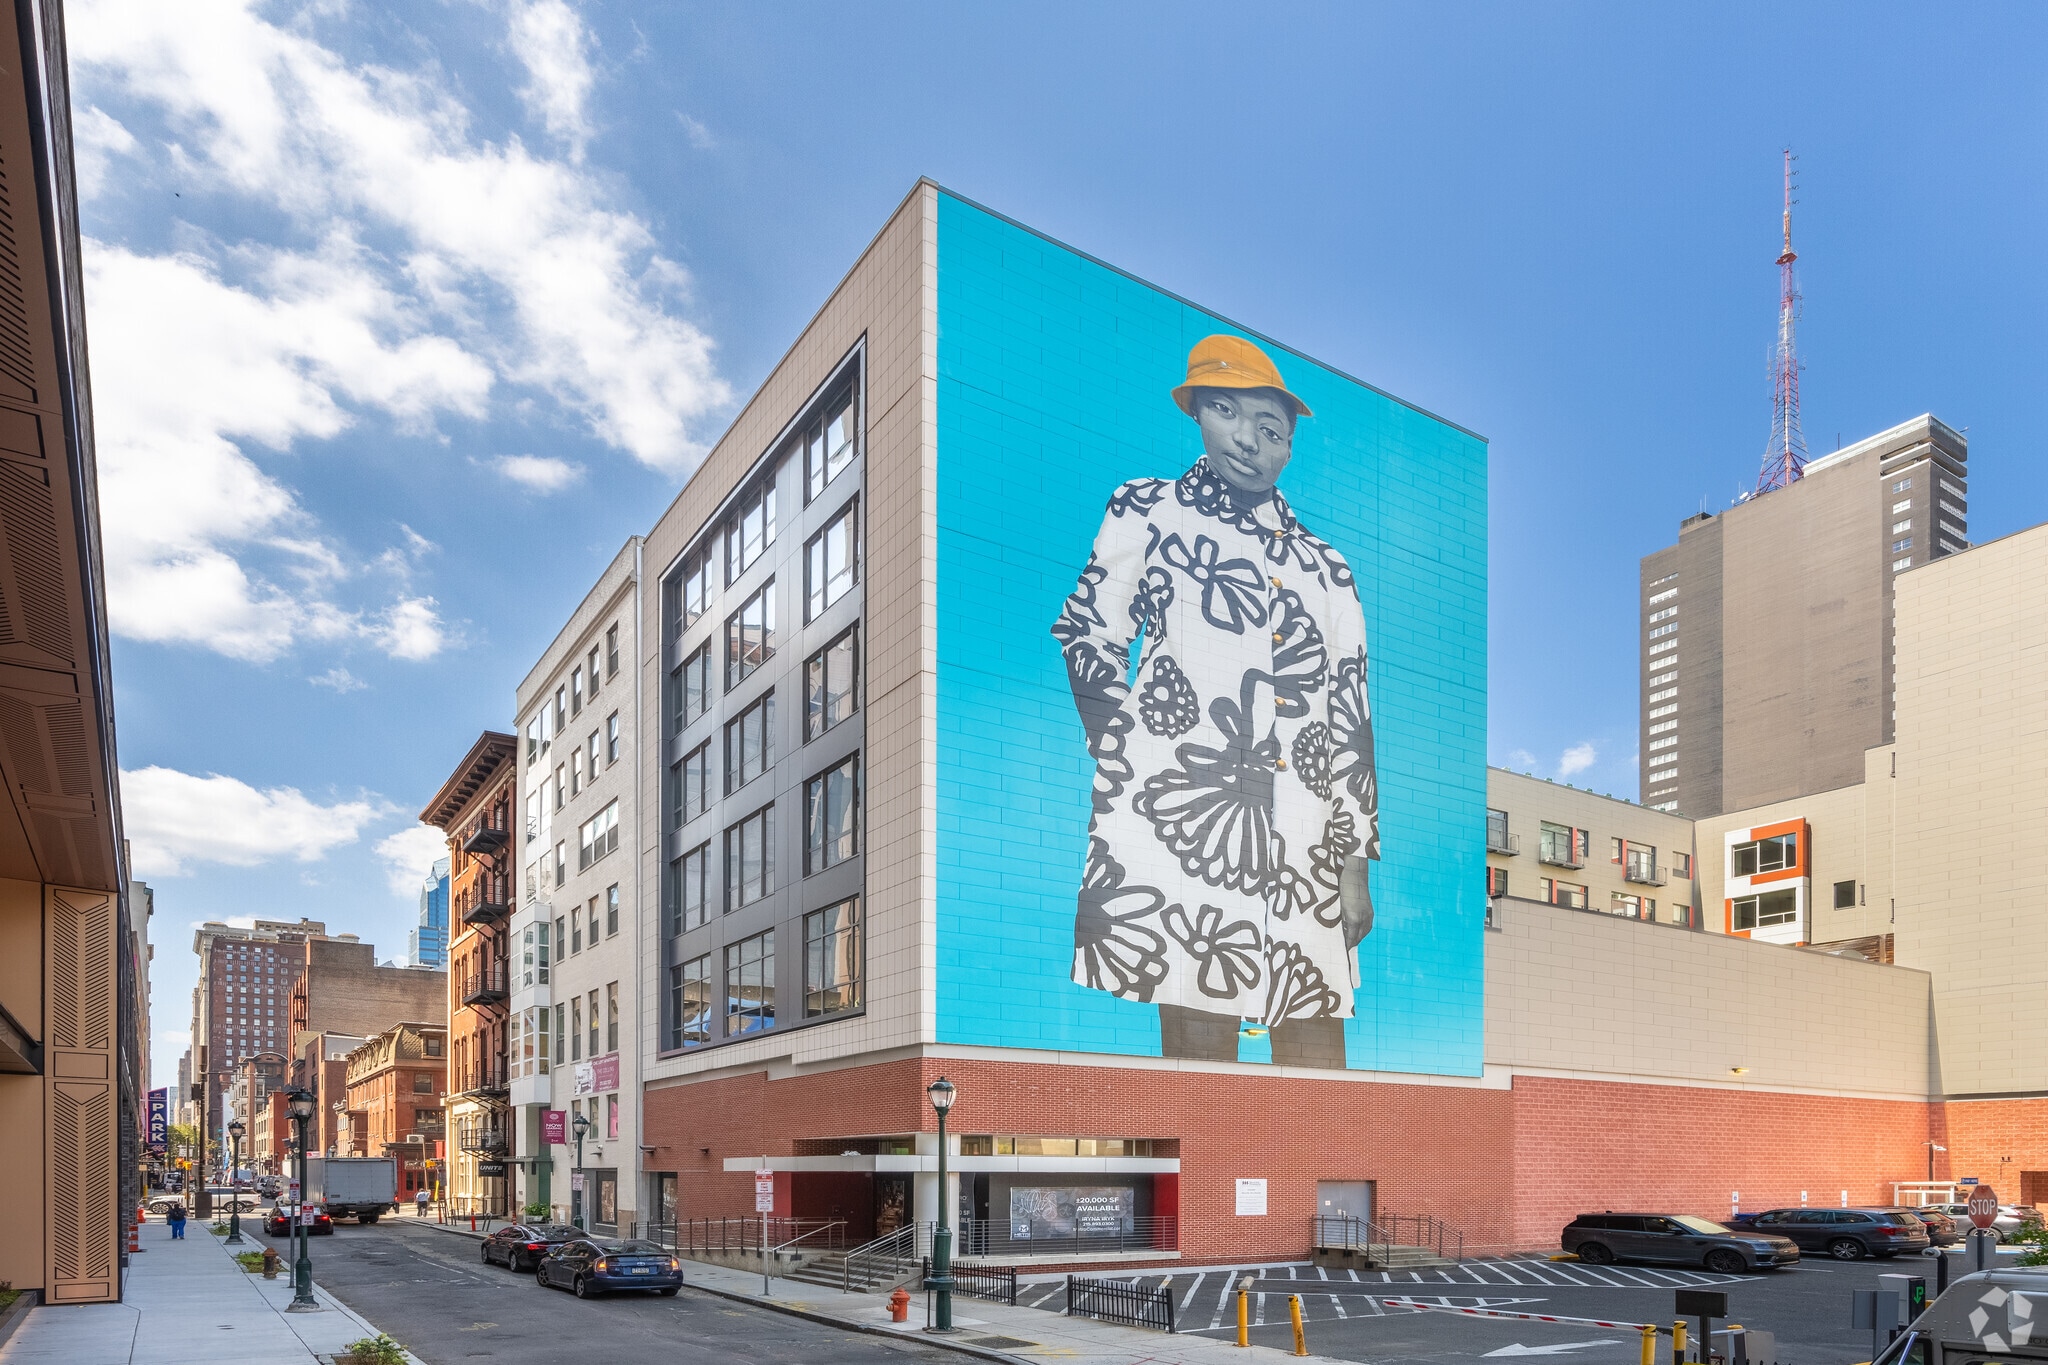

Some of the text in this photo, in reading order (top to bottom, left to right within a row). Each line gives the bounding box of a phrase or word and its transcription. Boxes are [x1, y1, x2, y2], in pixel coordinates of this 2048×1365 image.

[151, 1103, 165, 1142] PARK
[1109, 1196, 1119, 1204] SF
[1970, 1199, 1996, 1215] STOP
